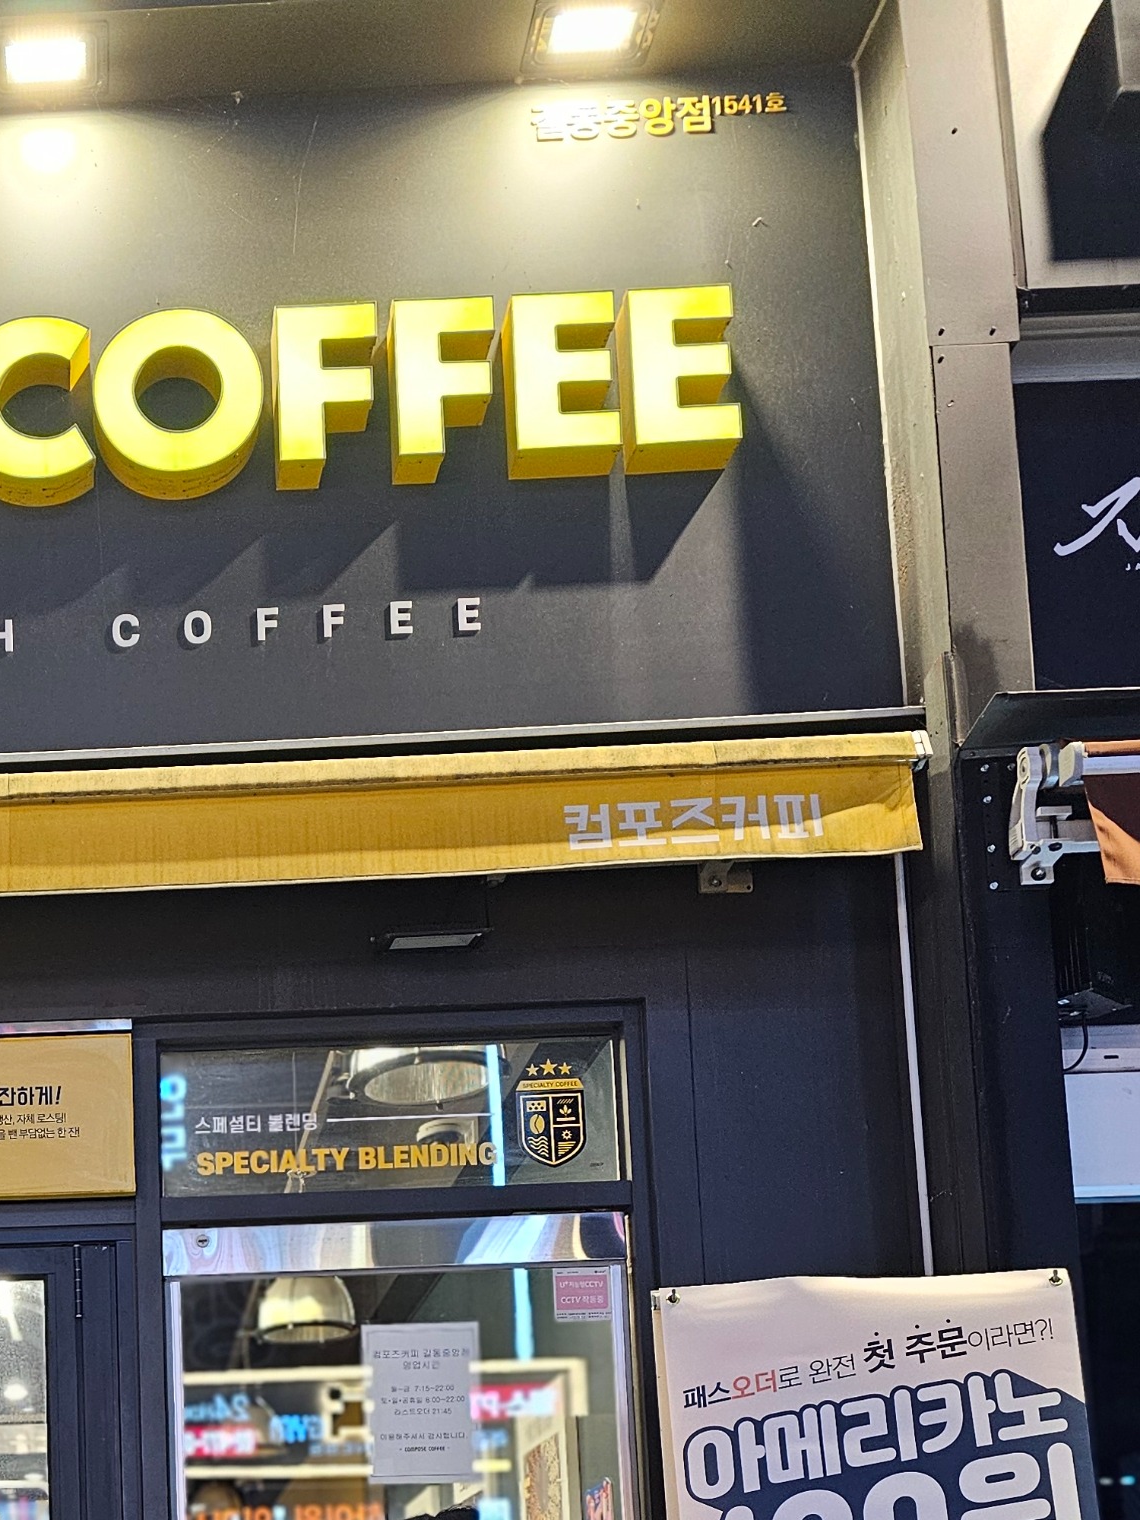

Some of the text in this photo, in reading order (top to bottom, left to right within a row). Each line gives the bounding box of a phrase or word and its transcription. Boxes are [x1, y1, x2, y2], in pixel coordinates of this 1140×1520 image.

[711, 91, 788, 115] 1541호
[111, 596, 484, 650] COFFEE
[563, 793, 826, 851] 컴포즈커피
[16, 1113, 35, 1125] 자체
[57, 1126, 67, 1138] 한
[194, 1114, 262, 1135] 스페셜티
[196, 1141, 498, 1176] SPECIALTY BLENDING
[560, 1296, 581, 1304] CCTV
[682, 1364, 803, 1410] 패스오더로
[808, 1353, 857, 1386] 완전
[863, 1333, 897, 1373] 첫
[685, 1369, 1070, 1501] 아메리카노
